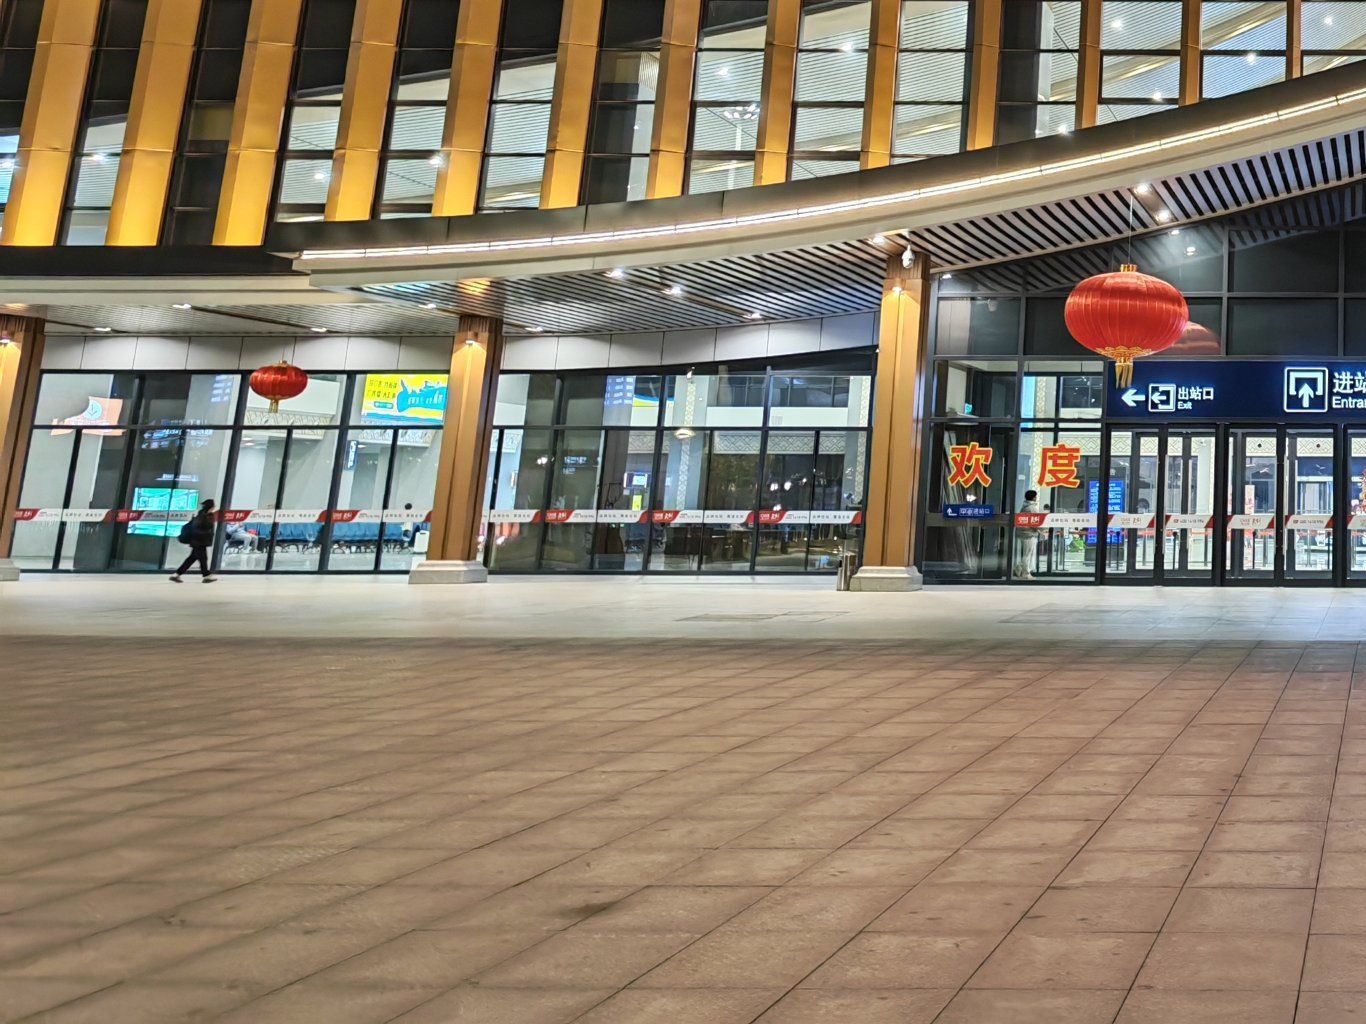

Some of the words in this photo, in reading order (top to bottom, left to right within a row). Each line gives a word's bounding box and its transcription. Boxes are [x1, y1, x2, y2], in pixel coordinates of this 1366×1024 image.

[1177, 386, 1214, 401] 出站口
[1177, 401, 1193, 410] Exit
